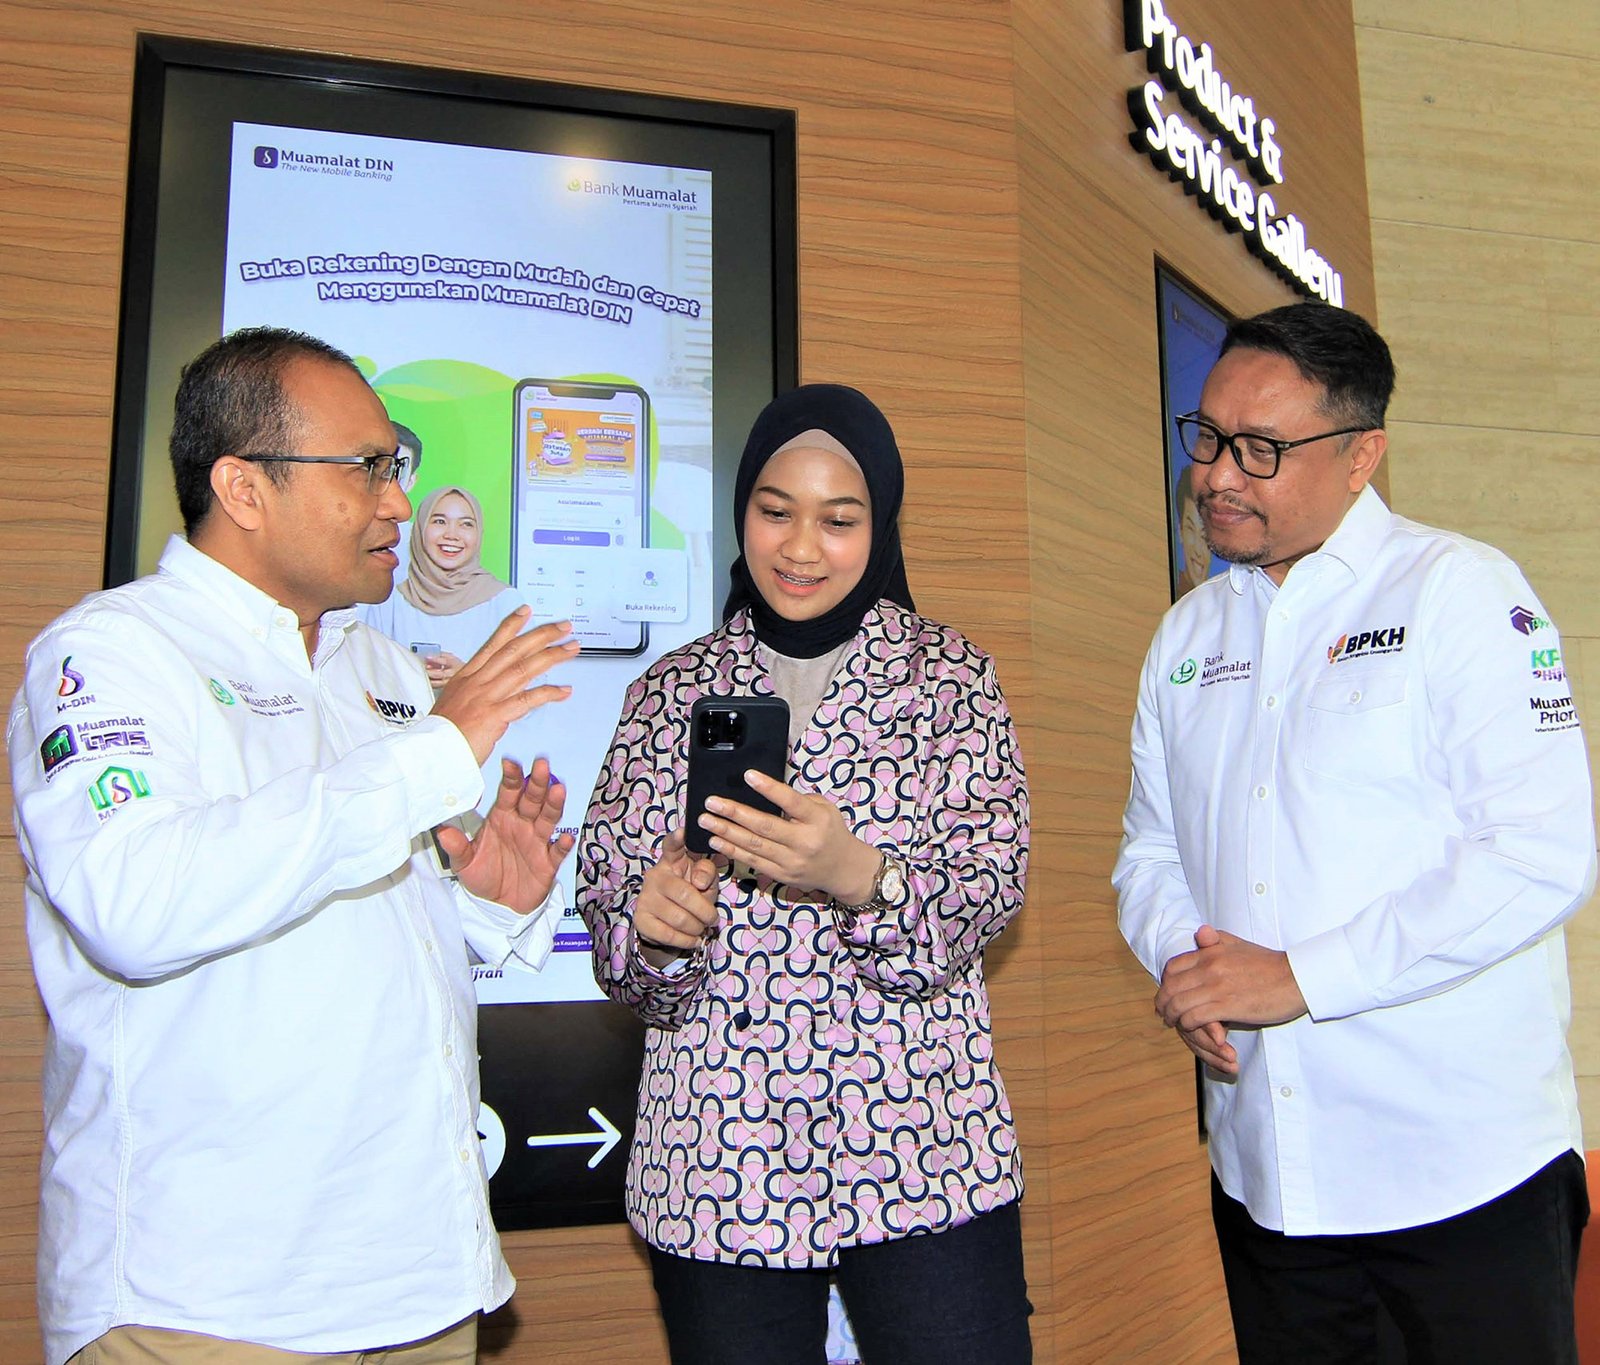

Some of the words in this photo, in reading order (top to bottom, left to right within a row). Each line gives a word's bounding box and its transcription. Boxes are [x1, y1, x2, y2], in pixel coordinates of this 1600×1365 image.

[281, 150, 361, 168] Muamalat
[365, 158, 394, 171] DIN
[1144, 80, 1255, 232] Service
[1261, 118, 1283, 184] &
[281, 163, 297, 171] The
[300, 164, 319, 173] New
[321, 167, 351, 176] Mobile
[354, 170, 392, 182] Banking
[584, 180, 619, 196] Bank
[622, 185, 697, 203] Muamalat
[623, 198, 650, 207] Pertama
[652, 201, 671, 209] Murni
[240, 258, 304, 281] Buka
[308, 252, 418, 275] Rekening
[422, 254, 511, 278] Dengan
[514, 261, 590, 290] Mudah
[592, 275, 635, 299] dan
[638, 286, 700, 317] Cepat
[318, 280, 478, 301] Menggunakan
[482, 284, 589, 315] Muamalat
[591, 300, 632, 324] DIN
[625, 603, 643, 611] Buka
[644, 603, 676, 612] Rekening
[1345, 626, 1405, 654] BPKH
[1204, 651, 1224, 668] Bank
[1202, 660, 1252, 680] Muamalat
[1542, 668, 1566, 681] Hij
[57, 694, 96, 713] M-DIN
[1529, 697, 1573, 710] Muam
[77, 716, 146, 733] Muamalat
[1540, 709, 1578, 724] Prior
[555, 827, 579, 836] sung
